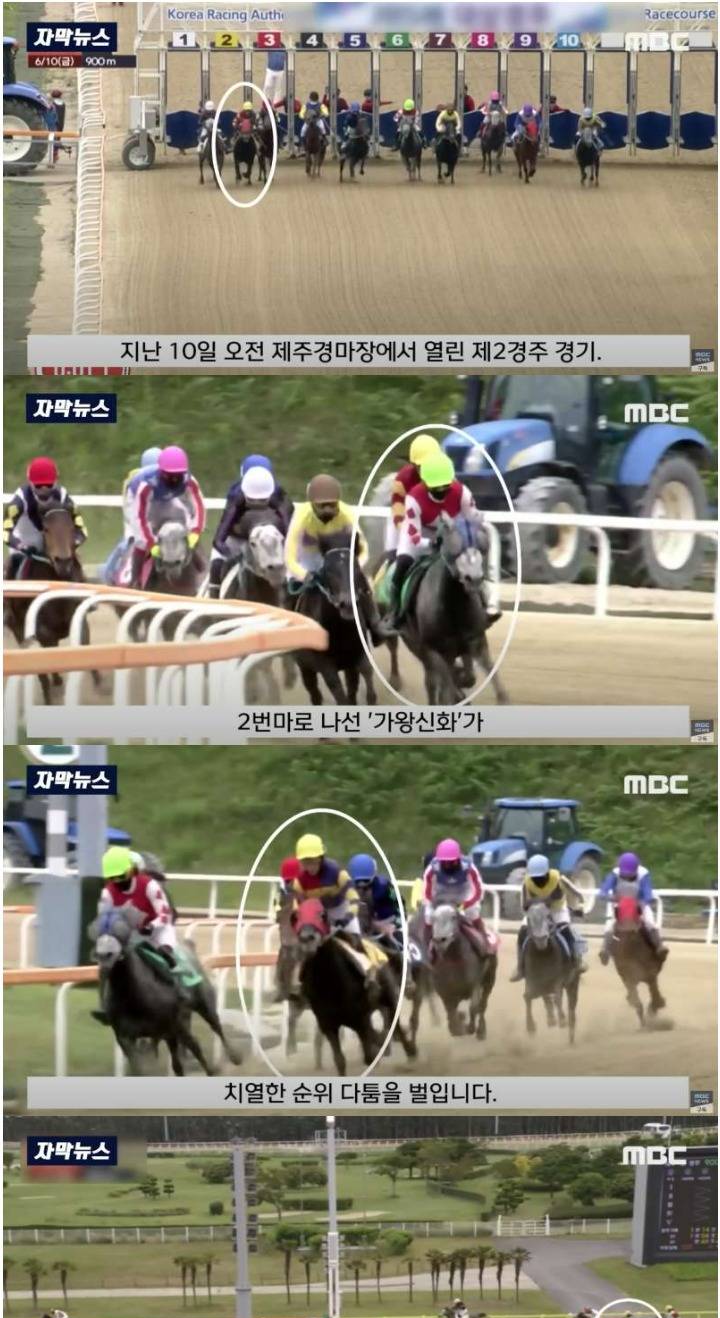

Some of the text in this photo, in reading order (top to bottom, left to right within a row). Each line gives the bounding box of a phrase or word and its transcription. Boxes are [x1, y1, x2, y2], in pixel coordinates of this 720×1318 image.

[168, 9, 203, 20] Korea
[207, 9, 248, 23] Racing
[645, 8, 716, 20] Racecourse
[180, 33, 188, 46] 1
[221, 33, 232, 46] 2
[263, 33, 276, 46] 3
[306, 33, 318, 46] 4
[350, 33, 361, 46] 5
[391, 33, 403, 46] 6
[435, 33, 446, 46] 7
[477, 33, 489, 46] 8
[520, 33, 531, 46] 9
[559, 33, 579, 46] 10
